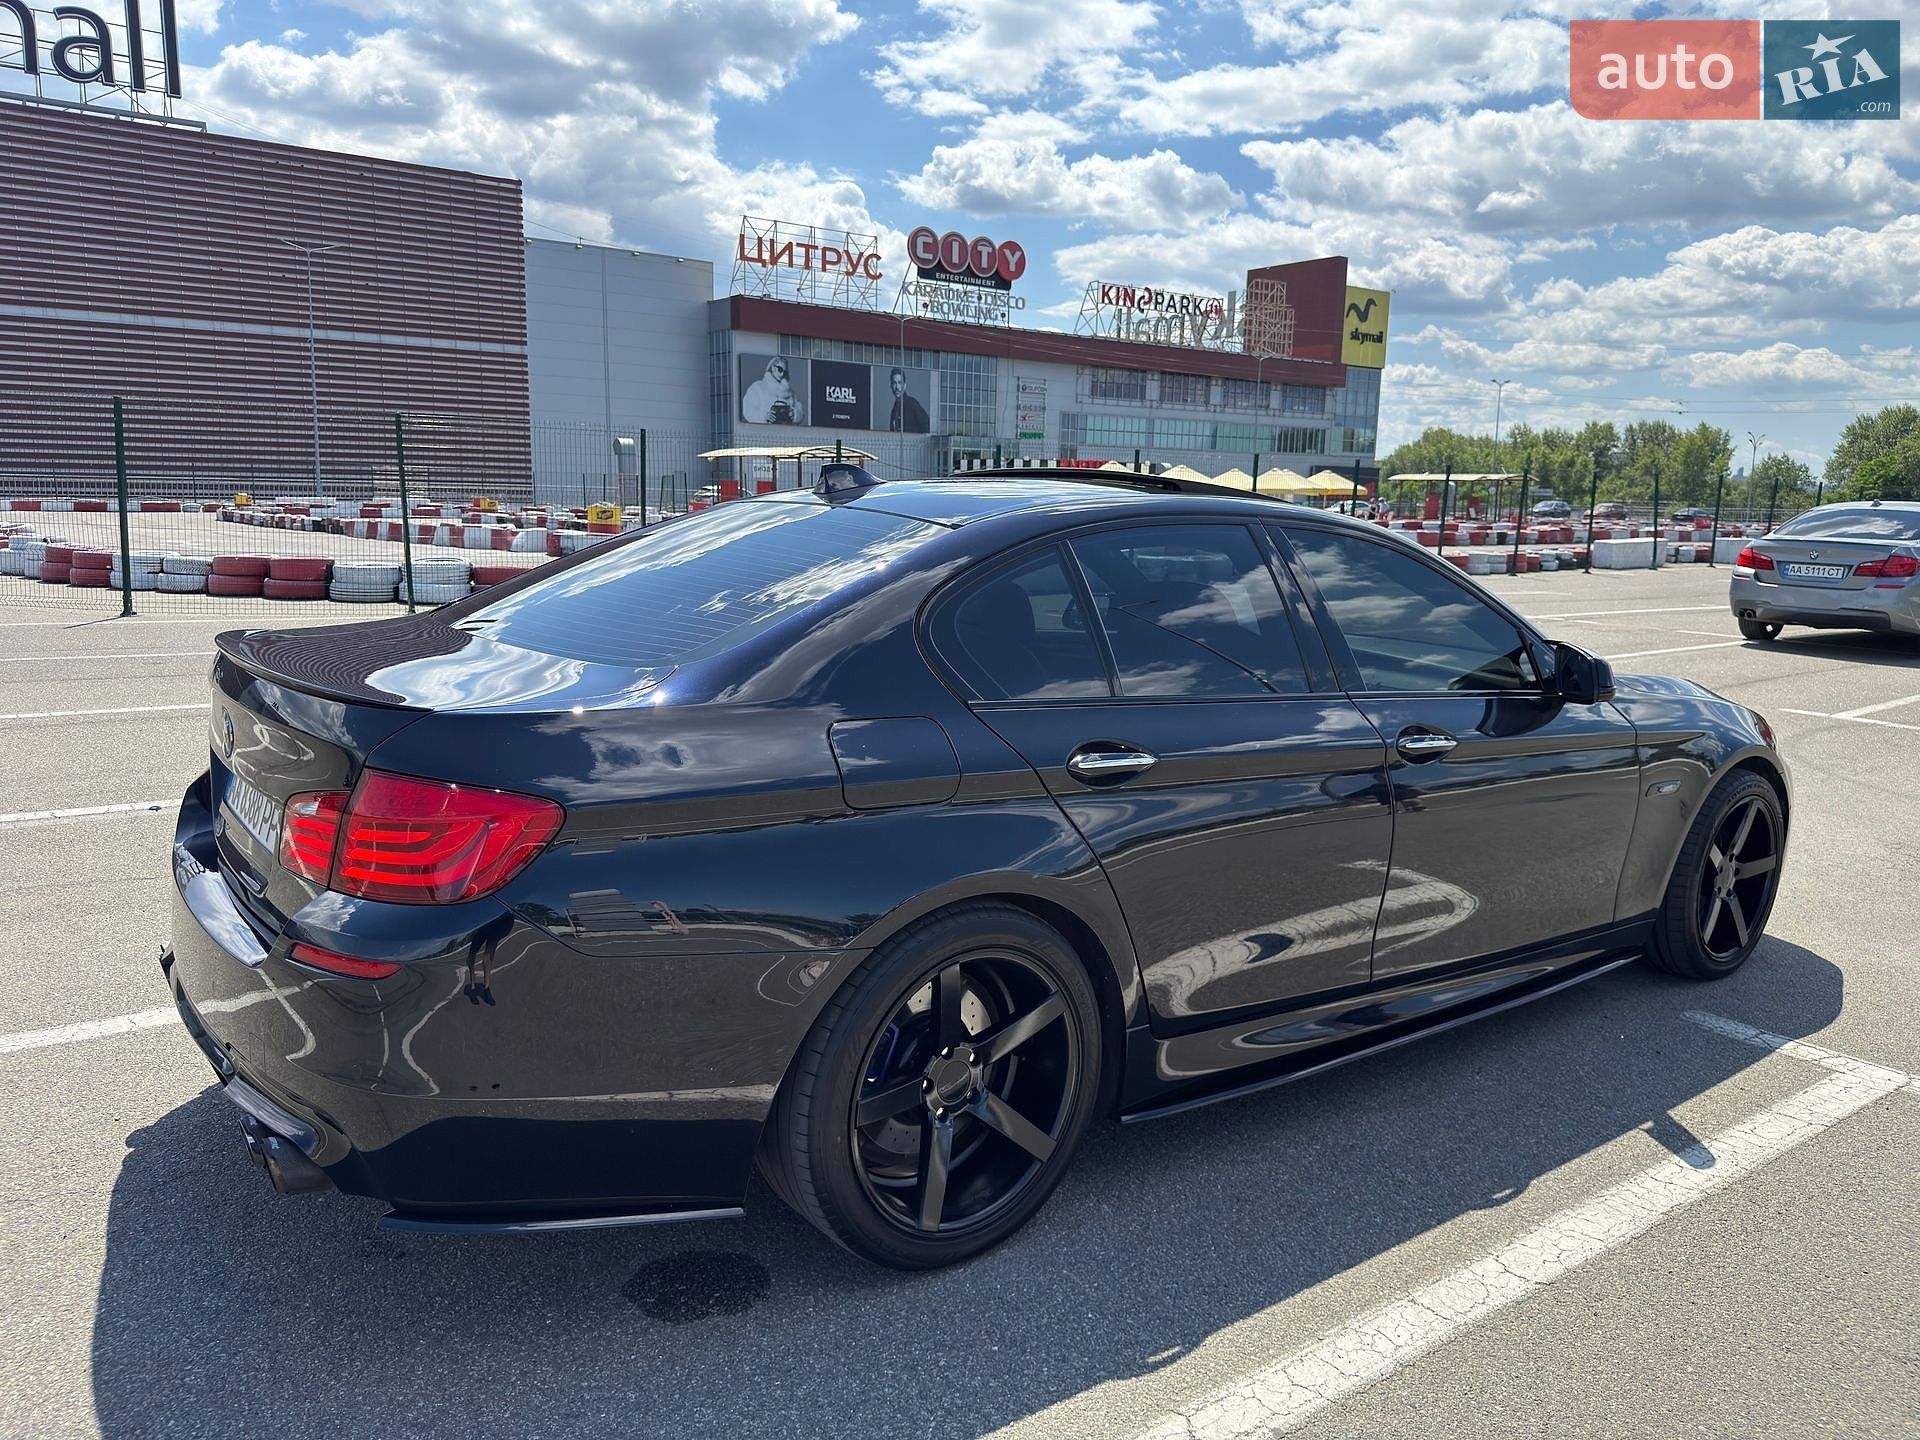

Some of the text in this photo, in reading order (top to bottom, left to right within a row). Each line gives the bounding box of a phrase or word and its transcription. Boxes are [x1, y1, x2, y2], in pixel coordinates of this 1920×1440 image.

[739, 233, 884, 281] ЦИТРУС
[915, 233, 1023, 273] CITY
[935, 272, 996, 287] ENTERTAINMENT
[902, 281, 1026, 310] KARAOKE DISCO
[930, 300, 999, 321] BOWLING
[1350, 328, 1384, 345] skymall
[826, 386, 856, 400] KARL
[1790, 565, 1842, 577] AA 5111 CT
